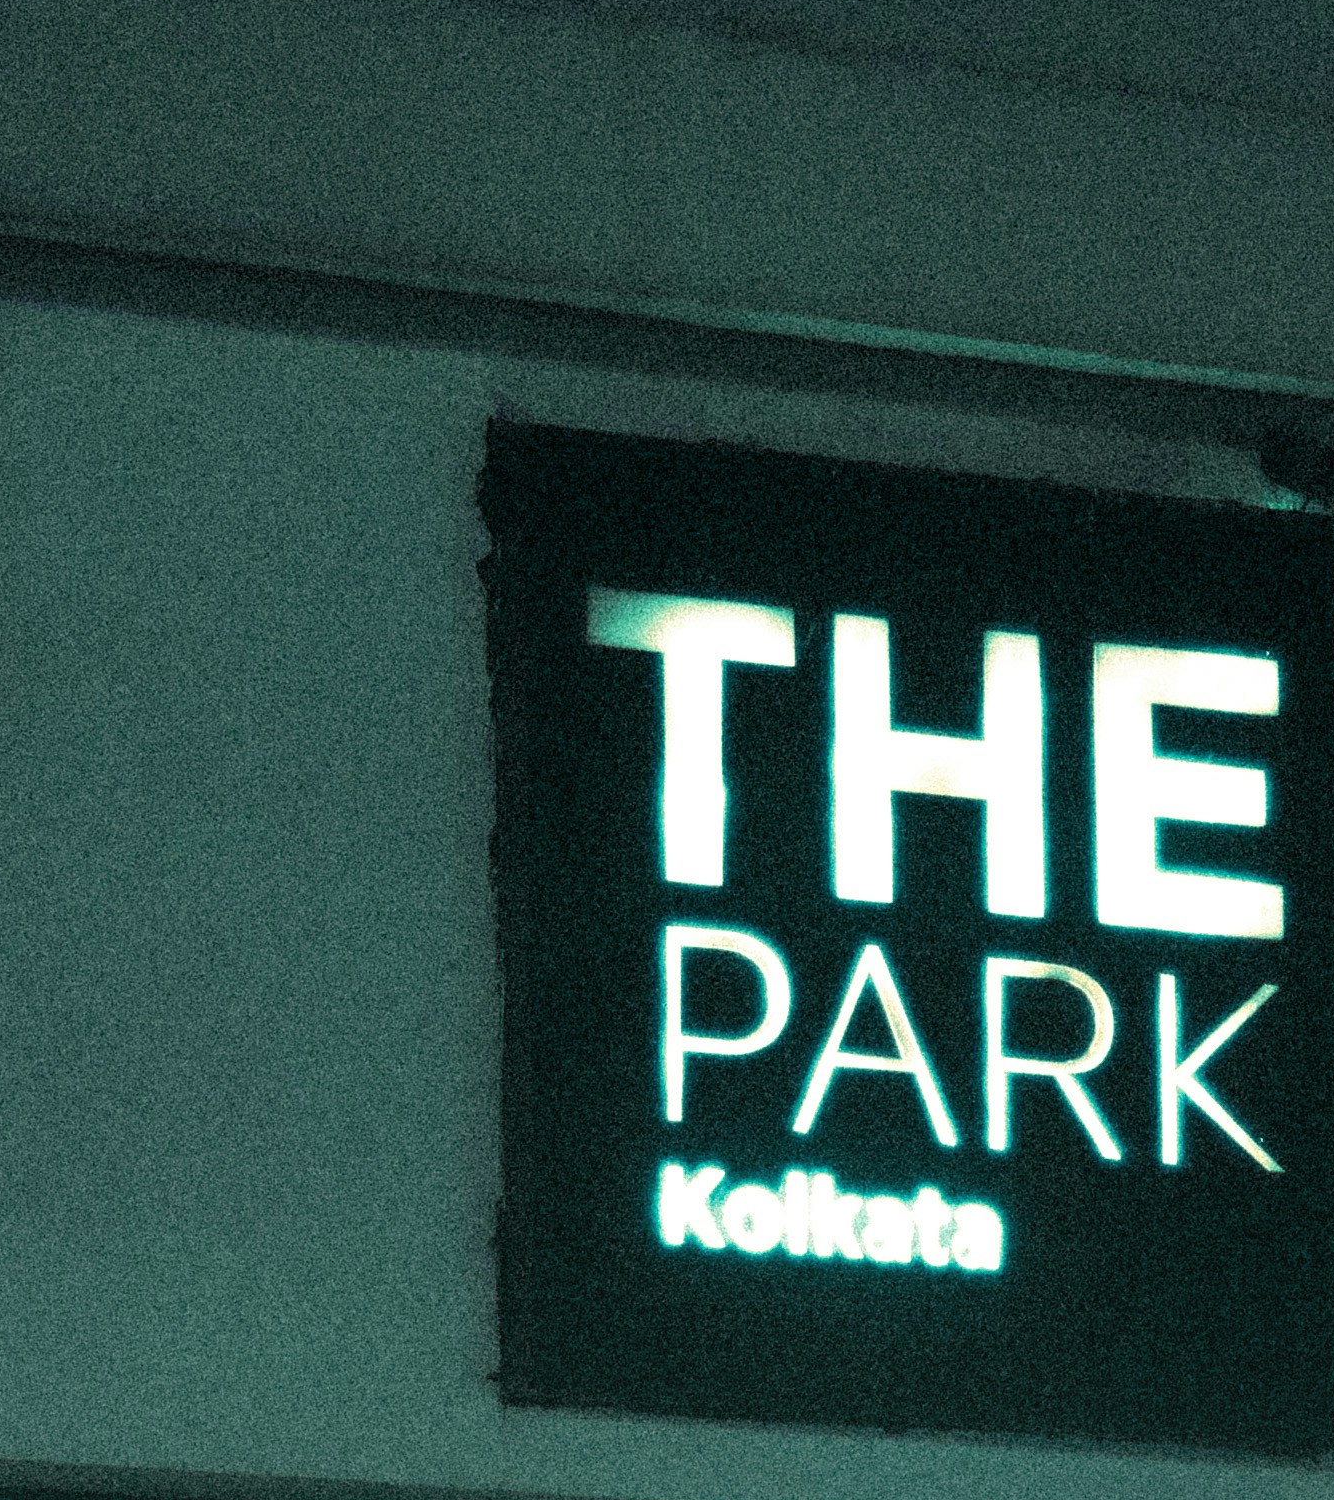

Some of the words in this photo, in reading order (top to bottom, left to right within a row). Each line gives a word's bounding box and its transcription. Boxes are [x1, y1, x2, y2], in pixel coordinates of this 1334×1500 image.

[586, 585, 1284, 940] THE
[660, 925, 1285, 1173] PARK
[655, 1161, 1005, 1274] Kolkata
